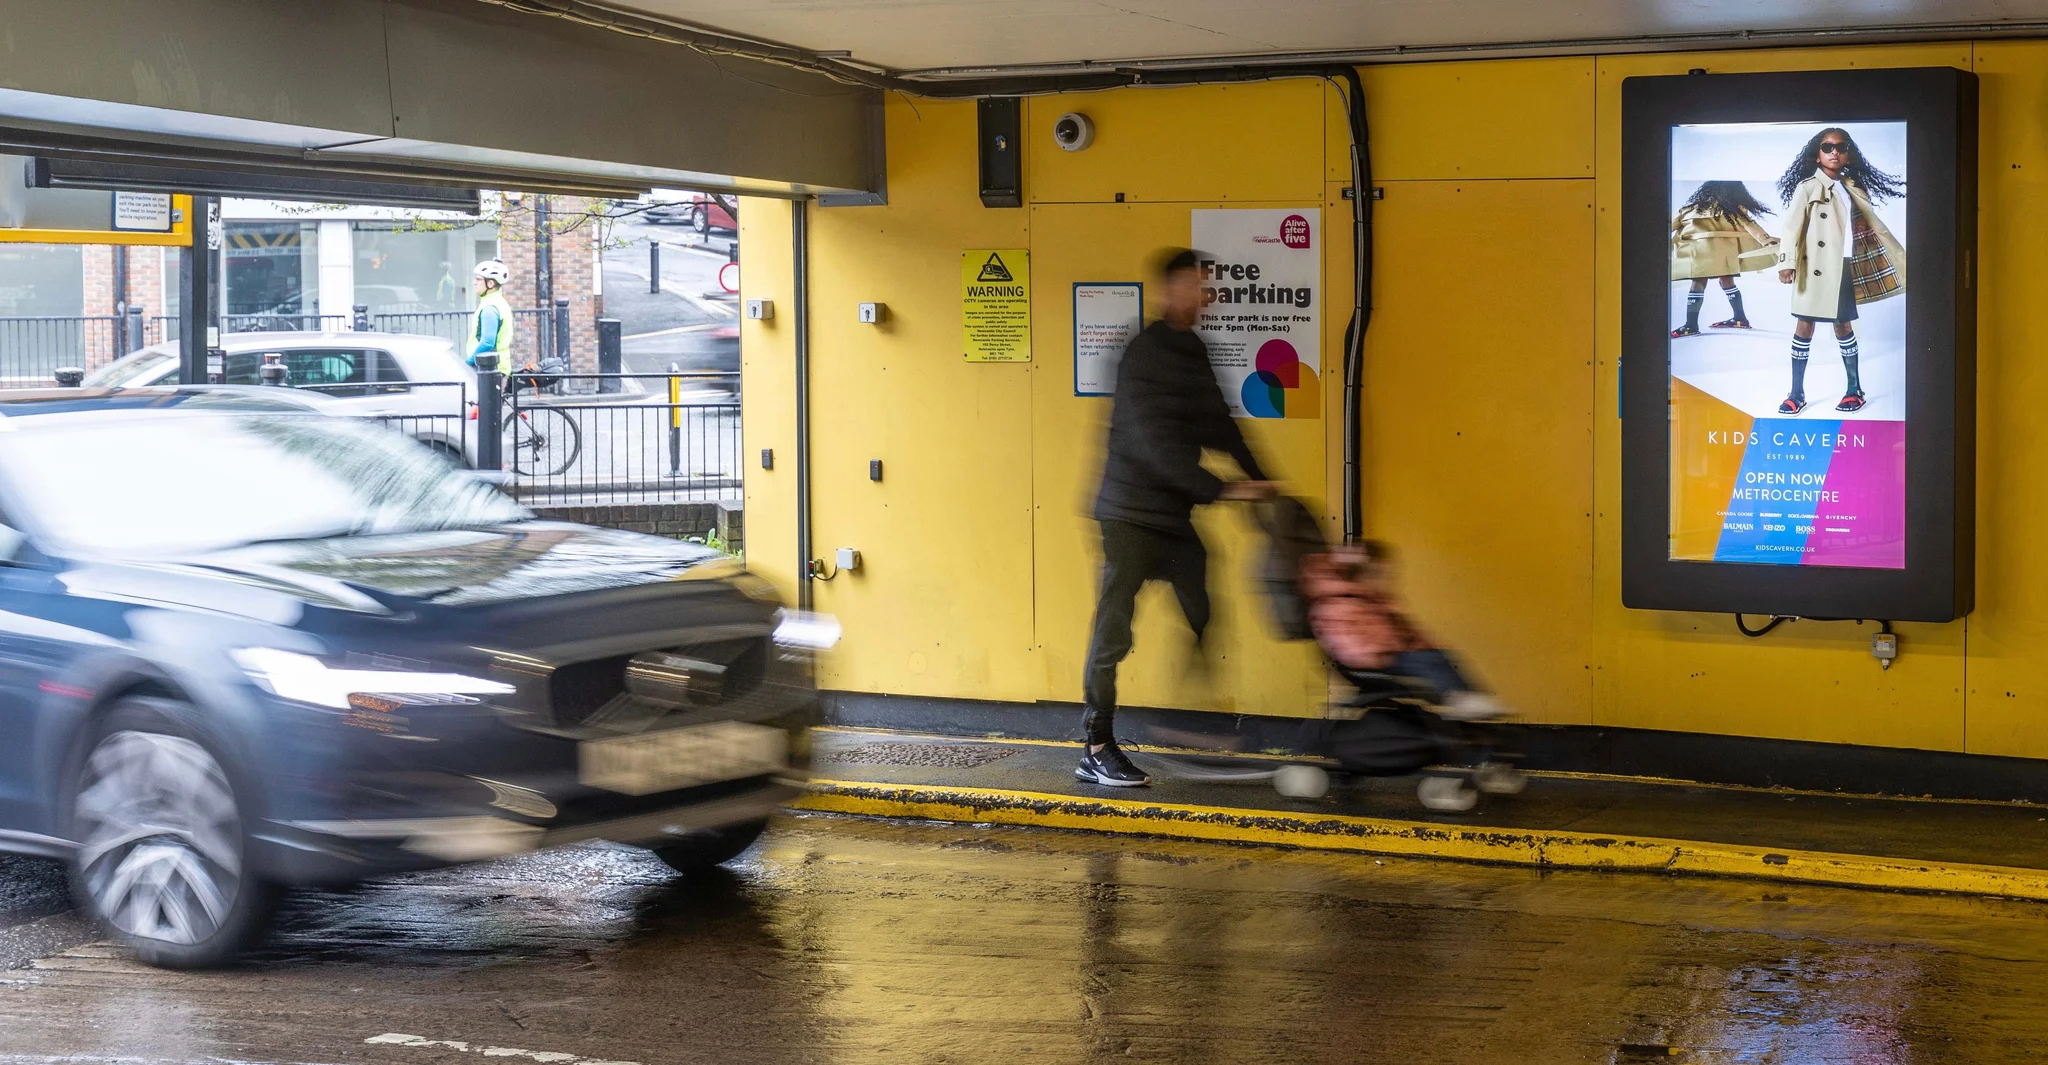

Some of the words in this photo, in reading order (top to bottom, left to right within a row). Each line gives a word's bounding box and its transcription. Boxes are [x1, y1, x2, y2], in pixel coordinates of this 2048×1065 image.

[1285, 234, 1306, 243] five
[1200, 260, 1260, 280] Free
[967, 286, 1024, 297] WARNING
[1200, 283, 1311, 308] parking
[1708, 431, 1759, 446] KIDS
[1773, 432, 1865, 447] CAVERN
[1746, 472, 1785, 484] OPEN
[1790, 473, 1826, 485] NOW
[1732, 488, 1839, 502] METROCENTRE
